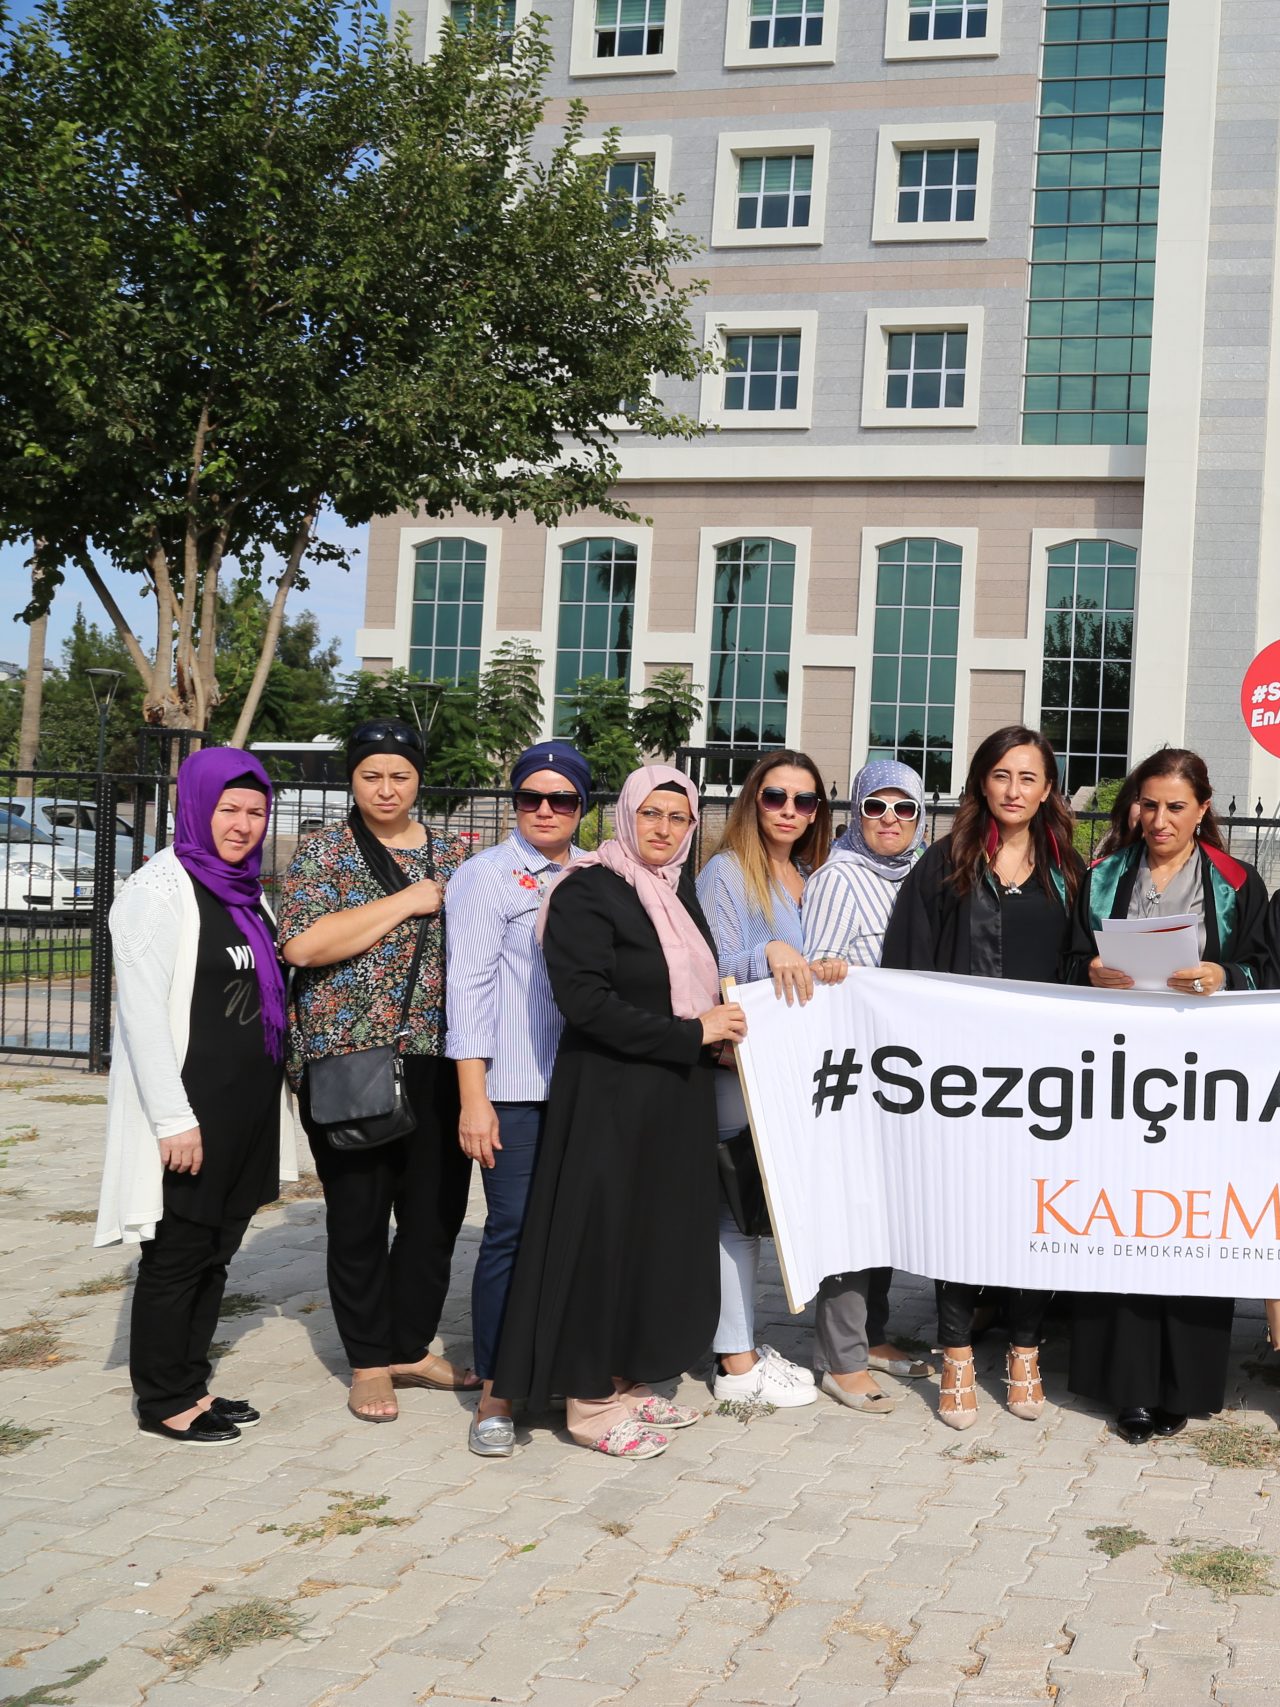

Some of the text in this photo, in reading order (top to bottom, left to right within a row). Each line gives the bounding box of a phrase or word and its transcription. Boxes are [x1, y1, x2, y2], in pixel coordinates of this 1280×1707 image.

[1029, 1240, 1079, 1254] KADIN
[1087, 1246, 1105, 1256] ve
[1113, 1243, 1211, 1259] DEMOKRASİ
